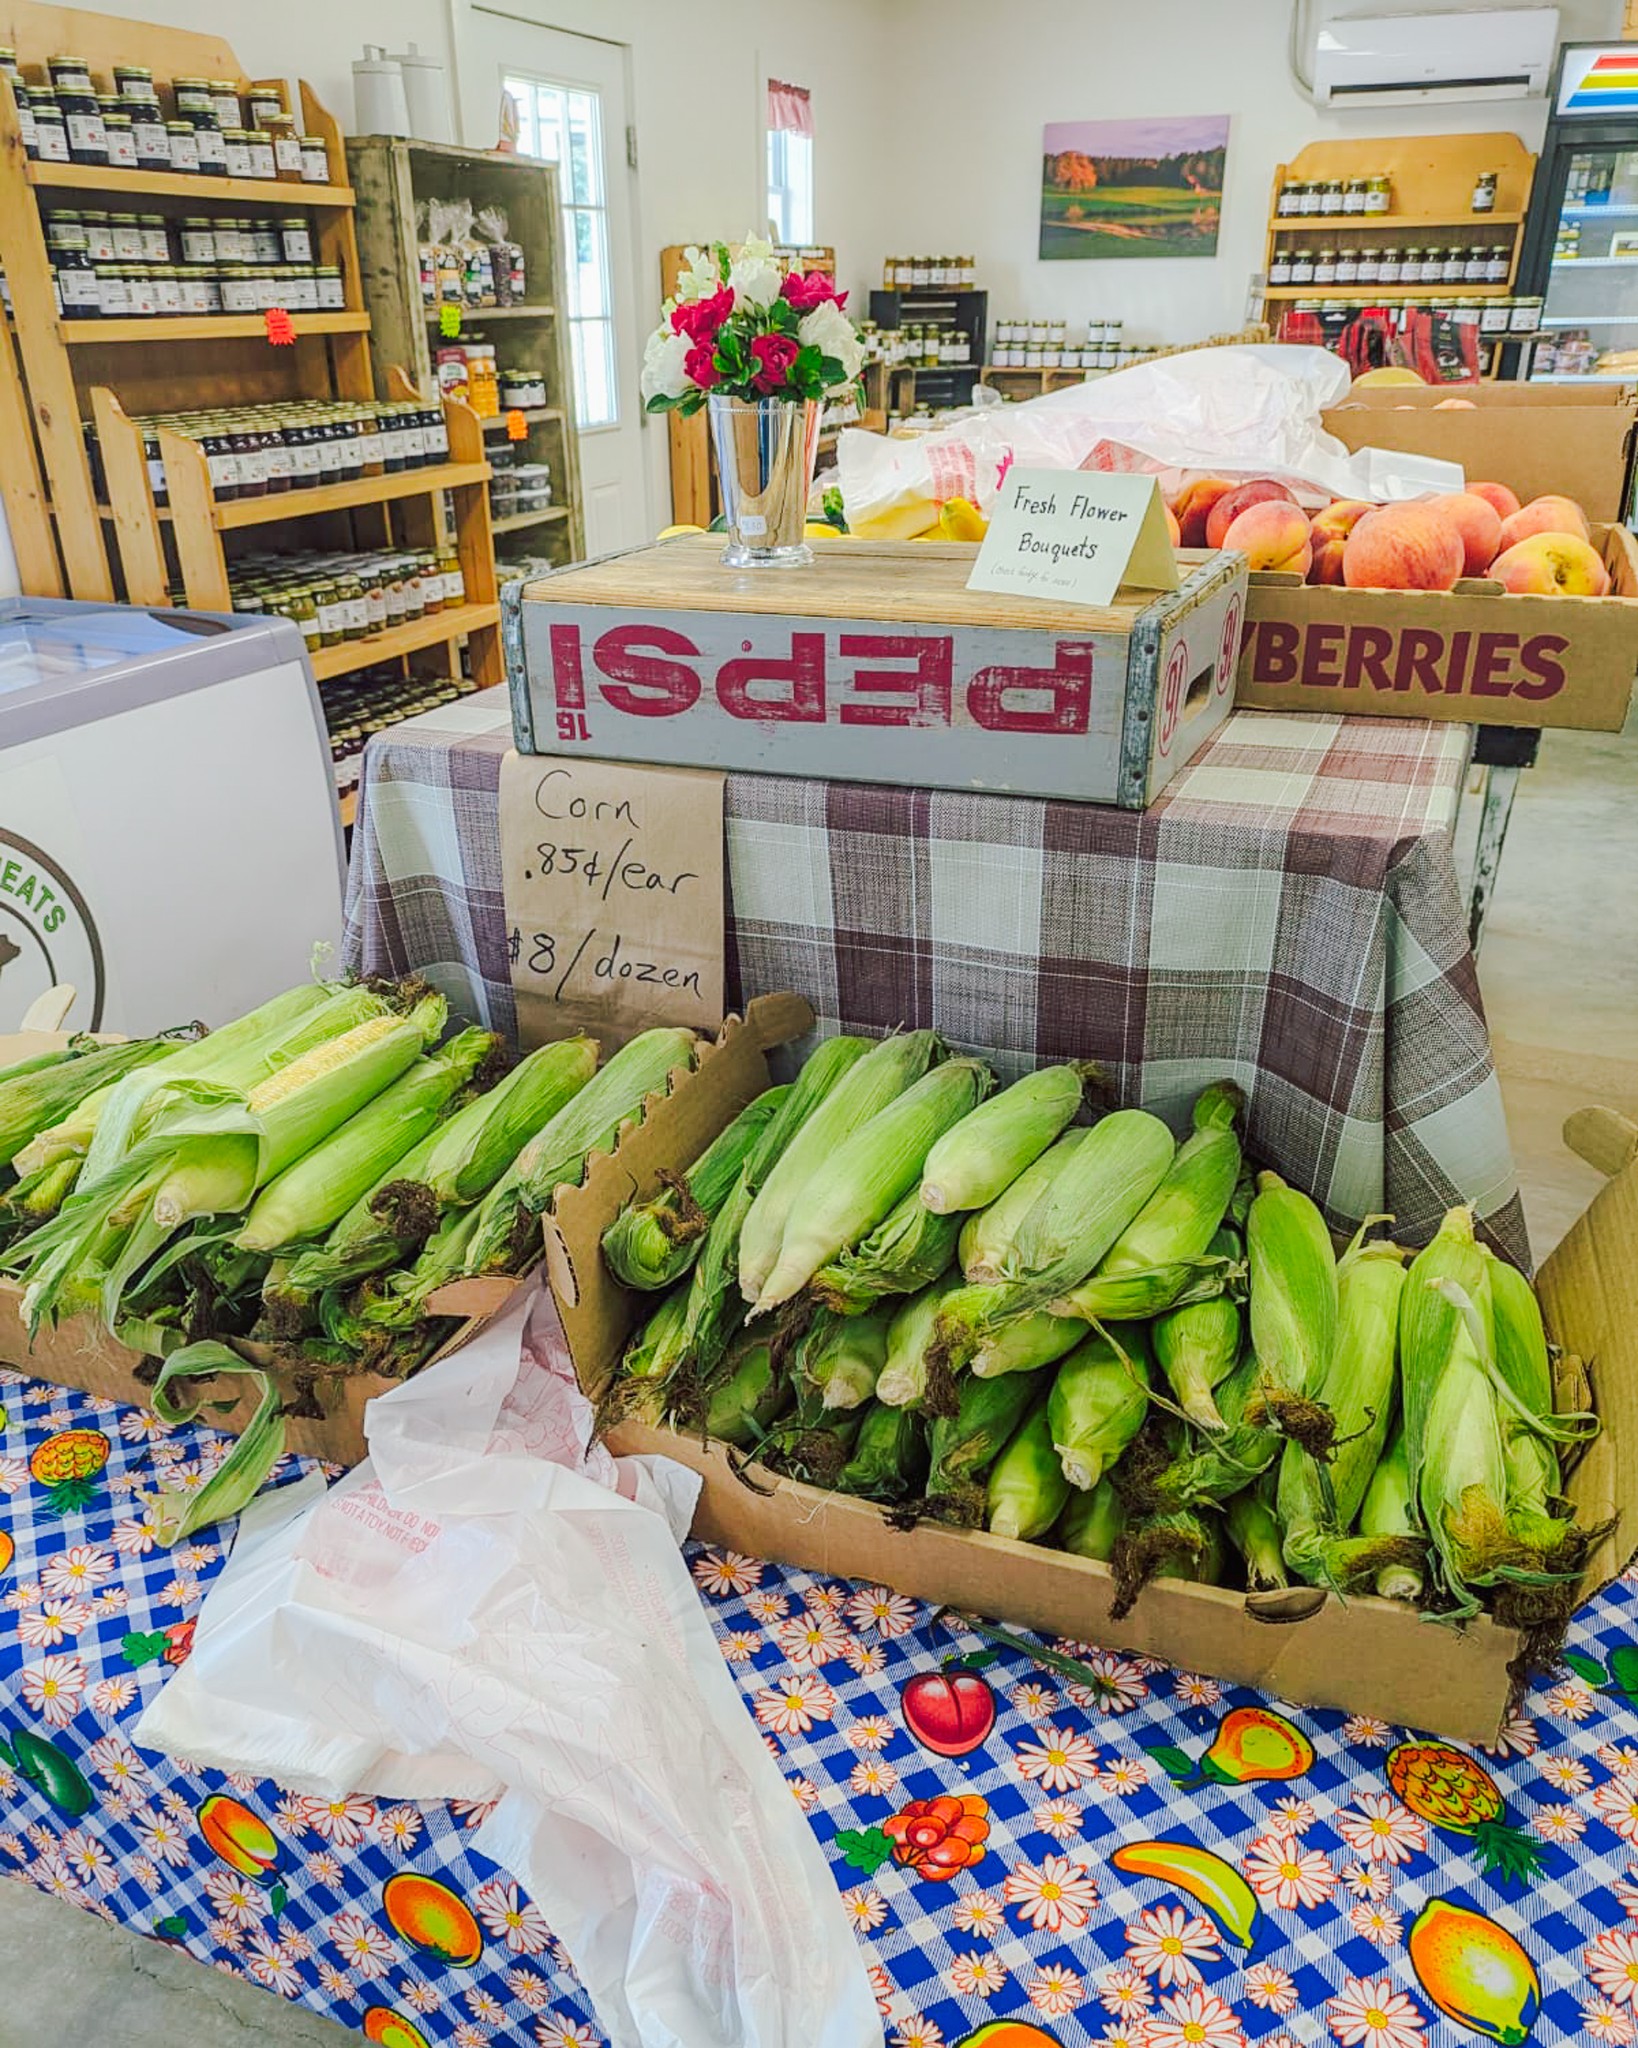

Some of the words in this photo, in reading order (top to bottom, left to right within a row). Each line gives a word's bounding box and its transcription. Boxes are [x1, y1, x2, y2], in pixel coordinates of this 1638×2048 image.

[1013, 485, 1057, 515] Fresh
[1069, 494, 1128, 523] Flower
[1018, 531, 1099, 564] Bouquets
[549, 624, 1095, 736] PEPSI
[555, 712, 593, 741] 16
[535, 768, 640, 829] Corn
[0, 857, 67, 934] EATS
[524, 837, 700, 901] .85¢/ear
